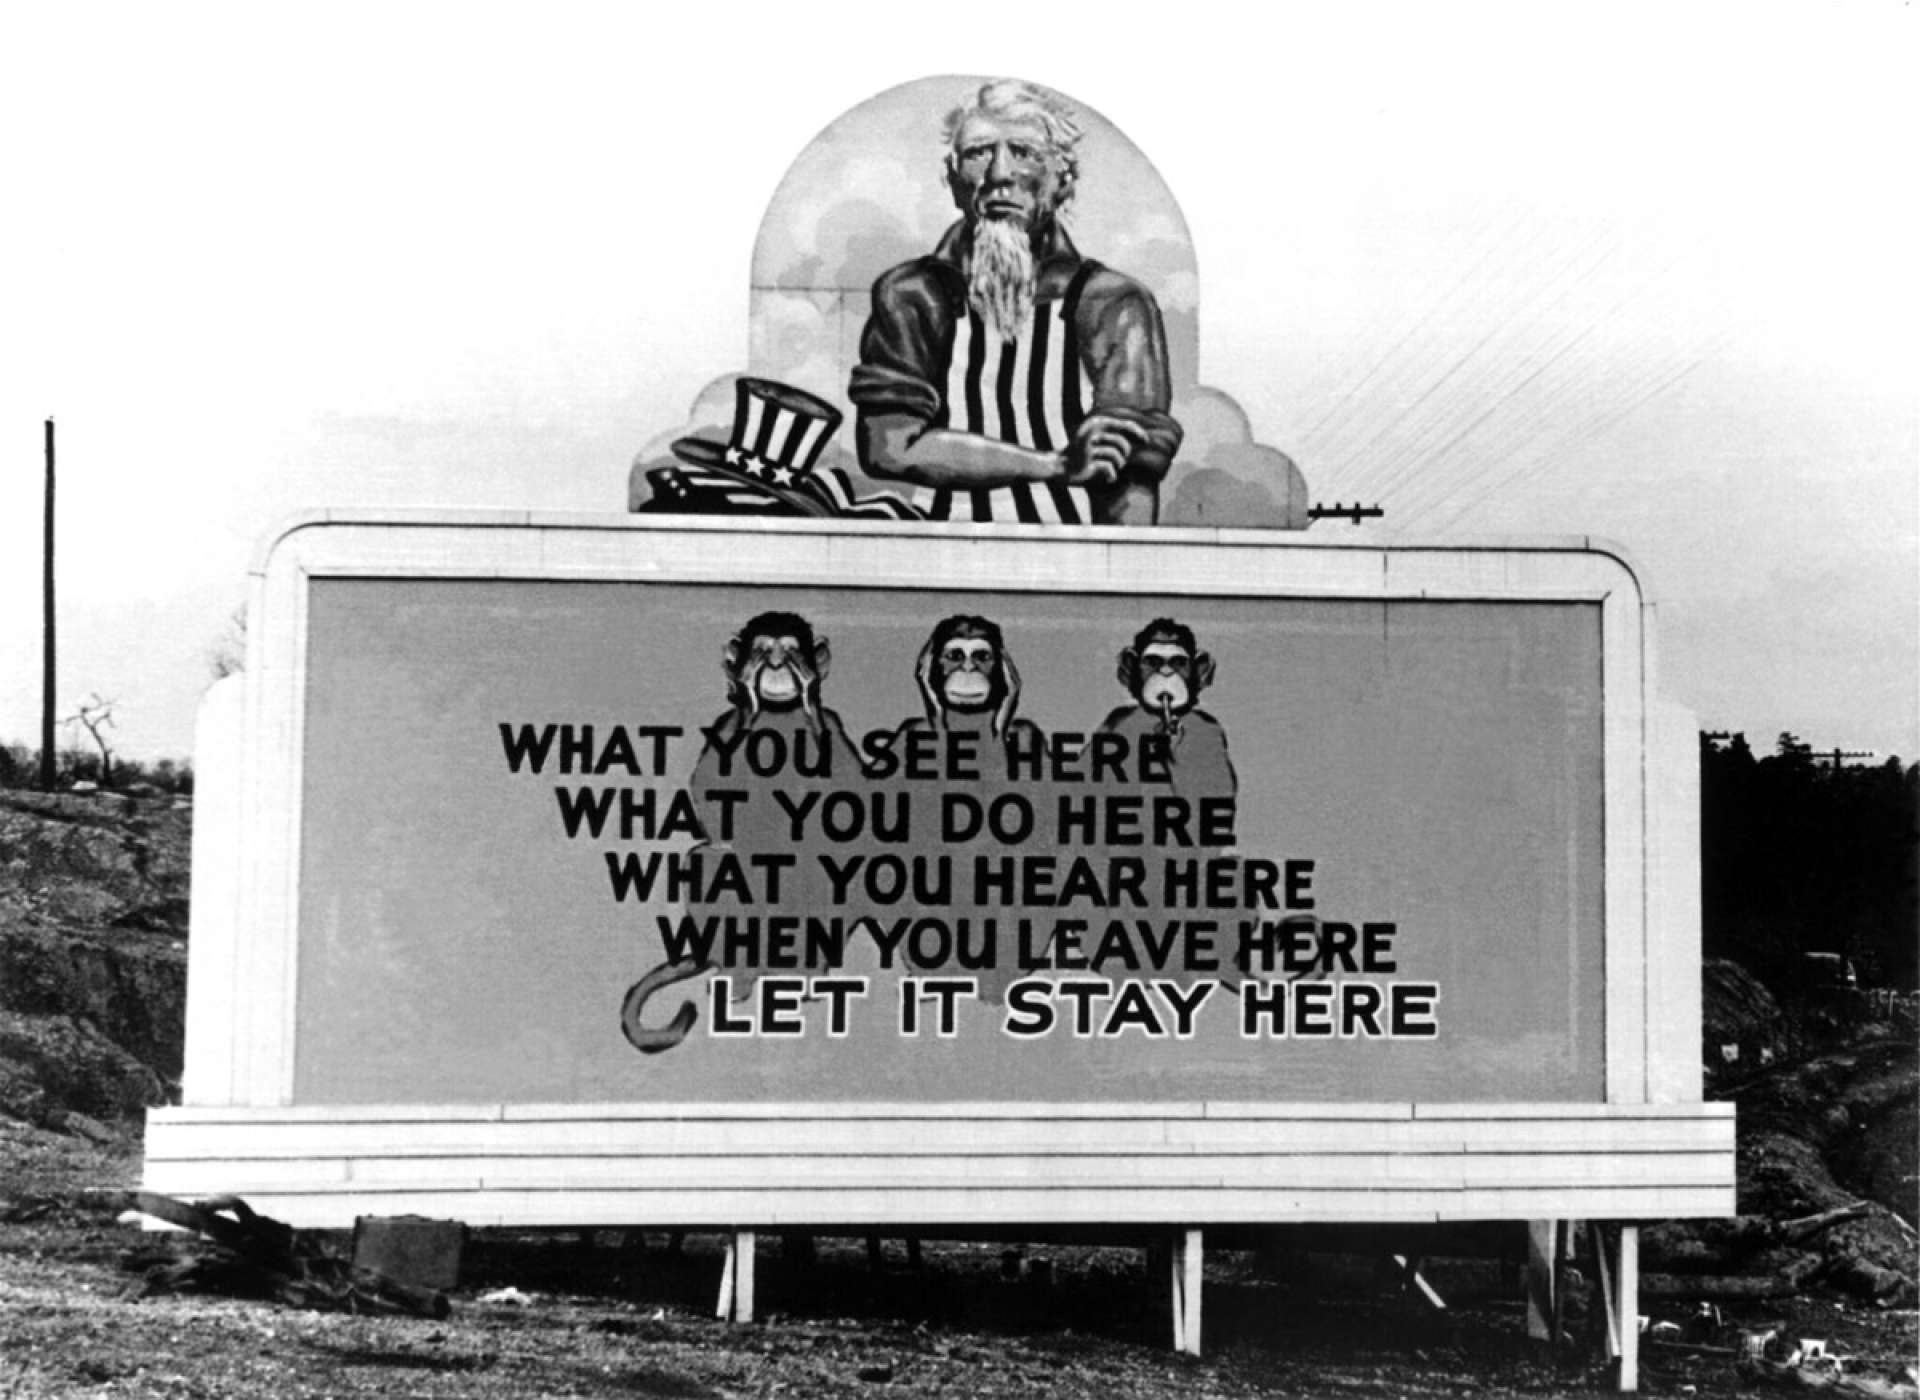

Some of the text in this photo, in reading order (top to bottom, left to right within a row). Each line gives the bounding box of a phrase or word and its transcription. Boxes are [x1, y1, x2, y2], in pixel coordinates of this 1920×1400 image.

[499, 723, 1173, 783] WHAT YOU SEE HERE
[555, 786, 1237, 847] WHAT YOU DO HERE
[604, 851, 1315, 910] WHAT YOU HEAR HERE
[656, 915, 1397, 974] WHEN YOU LEAVE HERE
[708, 976, 1440, 1040] LET IT STAY HERE
